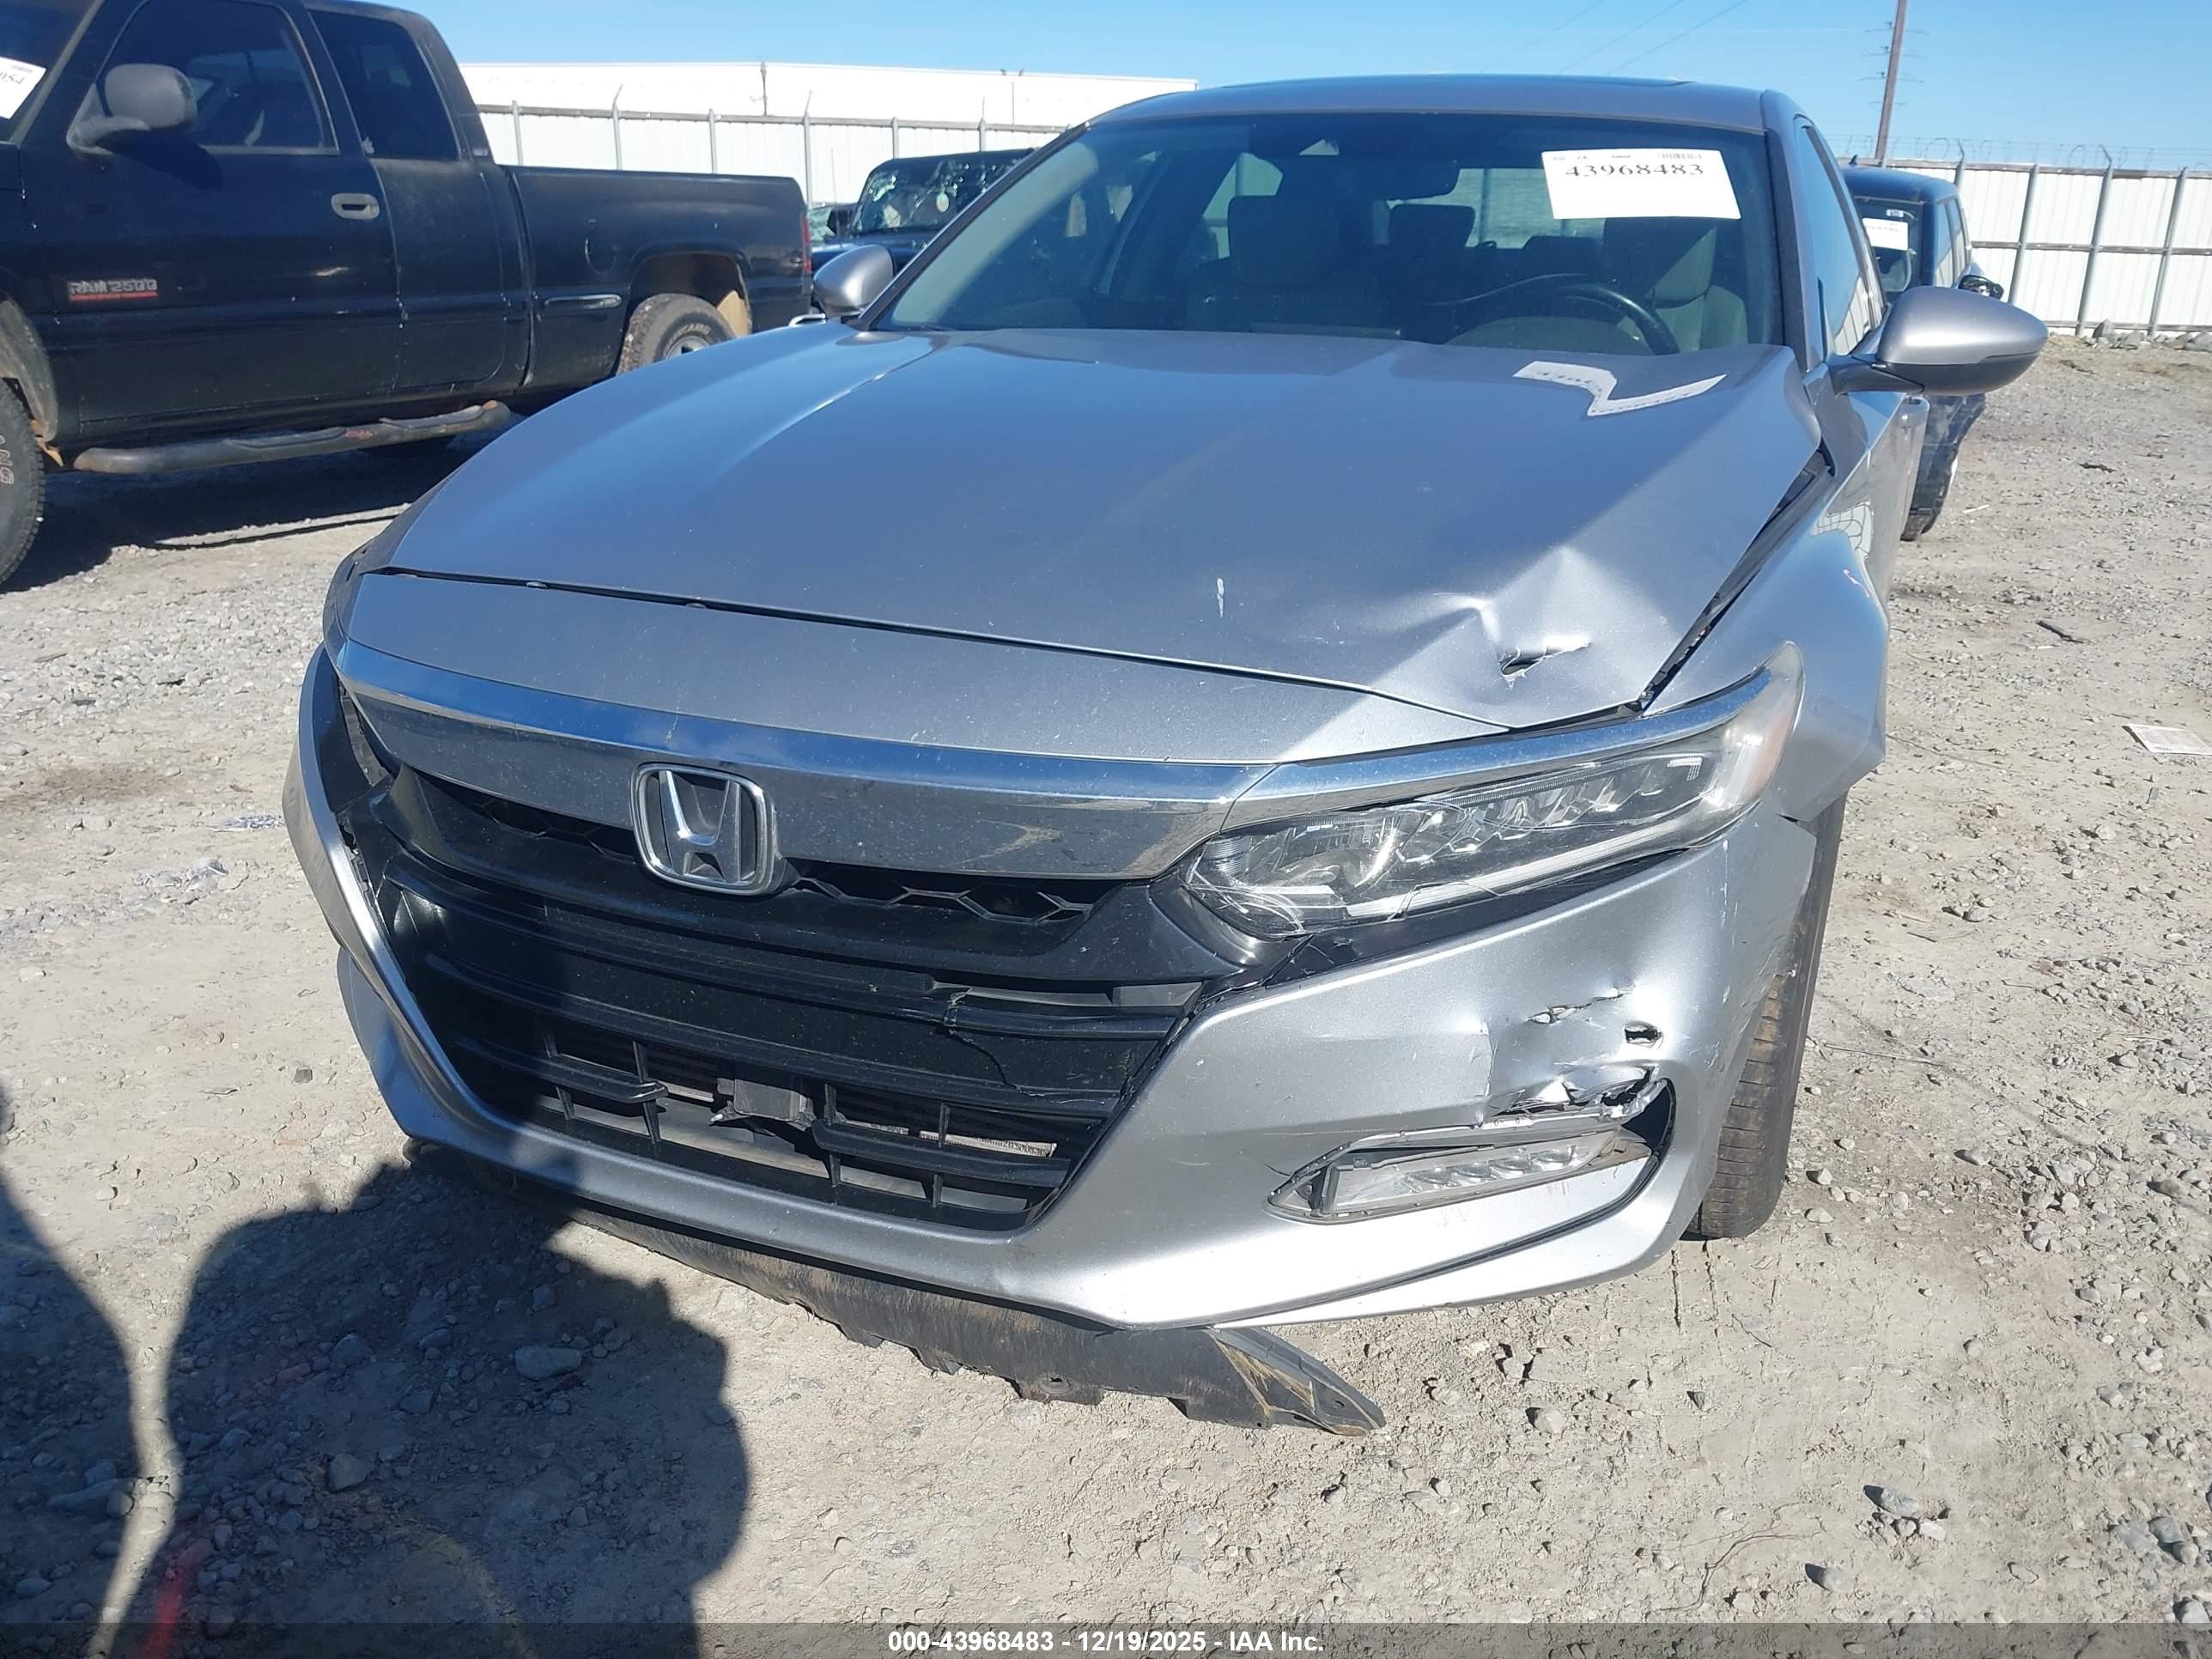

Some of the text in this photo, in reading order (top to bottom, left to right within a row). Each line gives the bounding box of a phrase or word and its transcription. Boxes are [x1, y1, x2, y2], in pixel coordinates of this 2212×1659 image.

[1565, 163, 1704, 178] 43968483
[68, 278, 157, 294] RAM 2500
